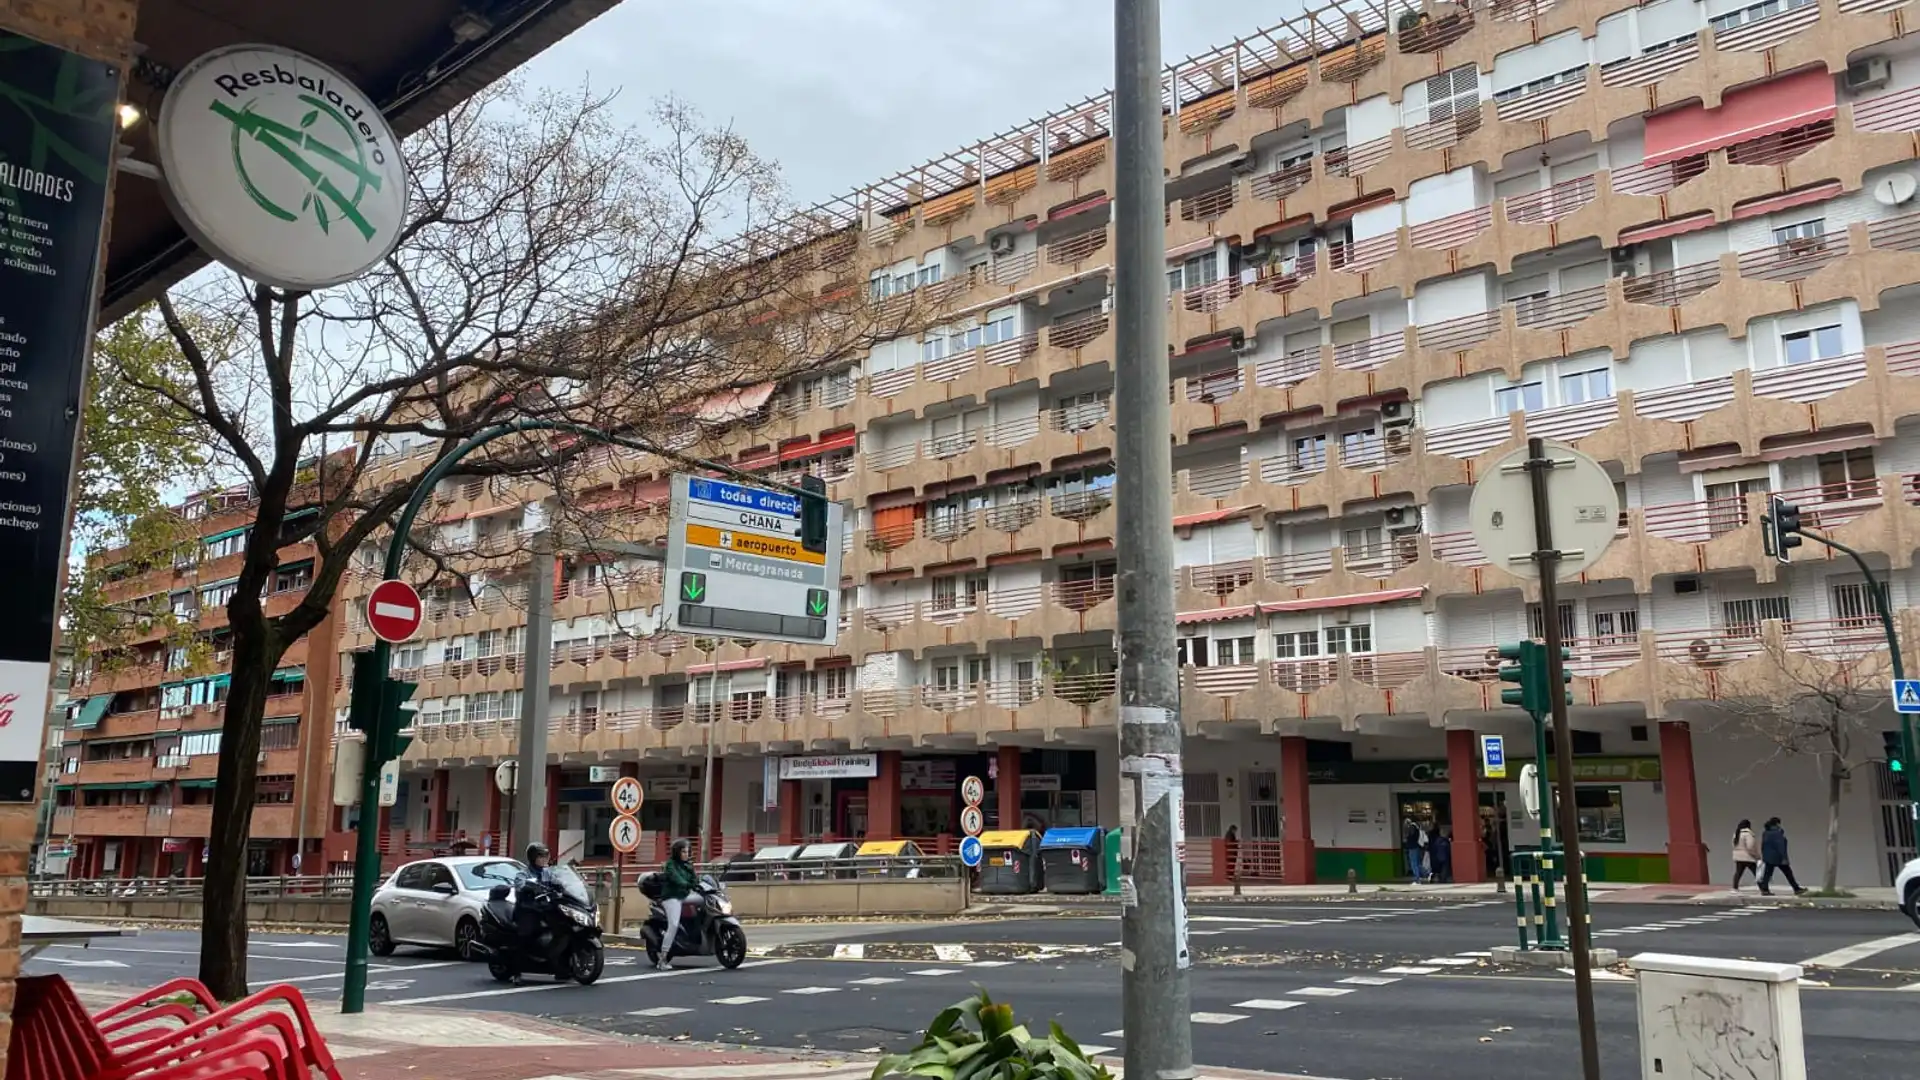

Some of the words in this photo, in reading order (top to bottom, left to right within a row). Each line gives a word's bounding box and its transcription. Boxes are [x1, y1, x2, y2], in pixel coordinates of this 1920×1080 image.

[214, 64, 385, 165] Resbaladero
[8, 213, 49, 230] ternera
[12, 229, 53, 246] ternera
[10, 244, 42, 258] cerdo
[4, 257, 57, 276] solomillo
[720, 487, 753, 504] todas
[739, 512, 783, 530] CHANA
[736, 535, 797, 556] aeropuerto
[724, 556, 804, 580] Mercagranada
